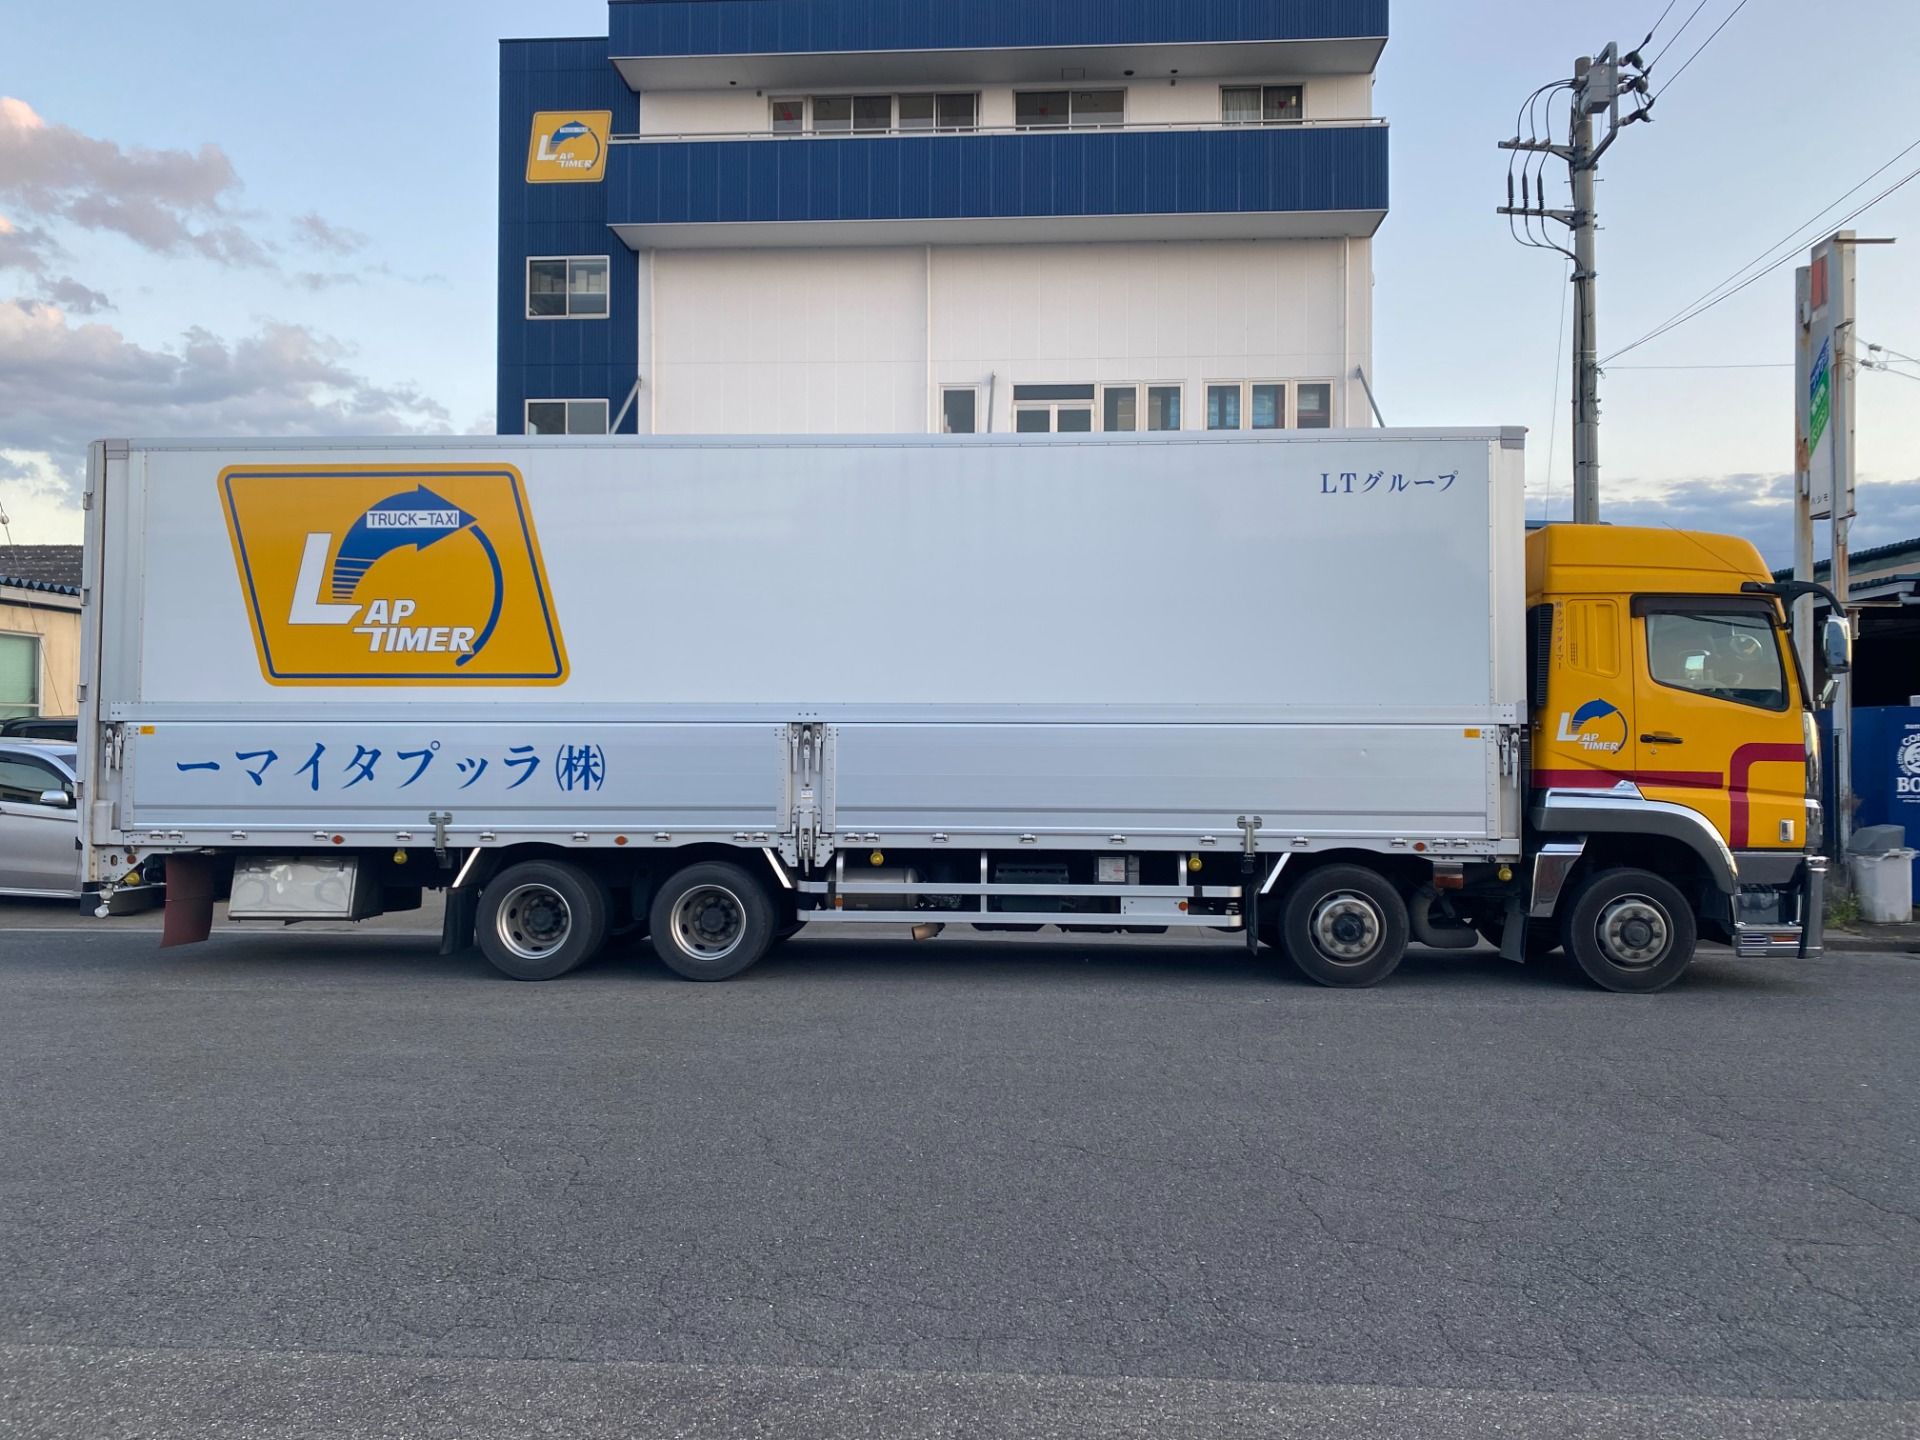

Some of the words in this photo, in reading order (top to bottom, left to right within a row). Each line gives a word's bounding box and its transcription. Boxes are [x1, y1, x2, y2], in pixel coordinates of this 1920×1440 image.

[556, 160, 593, 169] TIMER
[1321, 470, 1459, 494] LTグループ
[368, 512, 458, 527] TRUCK-TAXI
[288, 532, 416, 626] LAP
[353, 627, 476, 654] TIMER
[1578, 741, 1620, 751] TIMER
